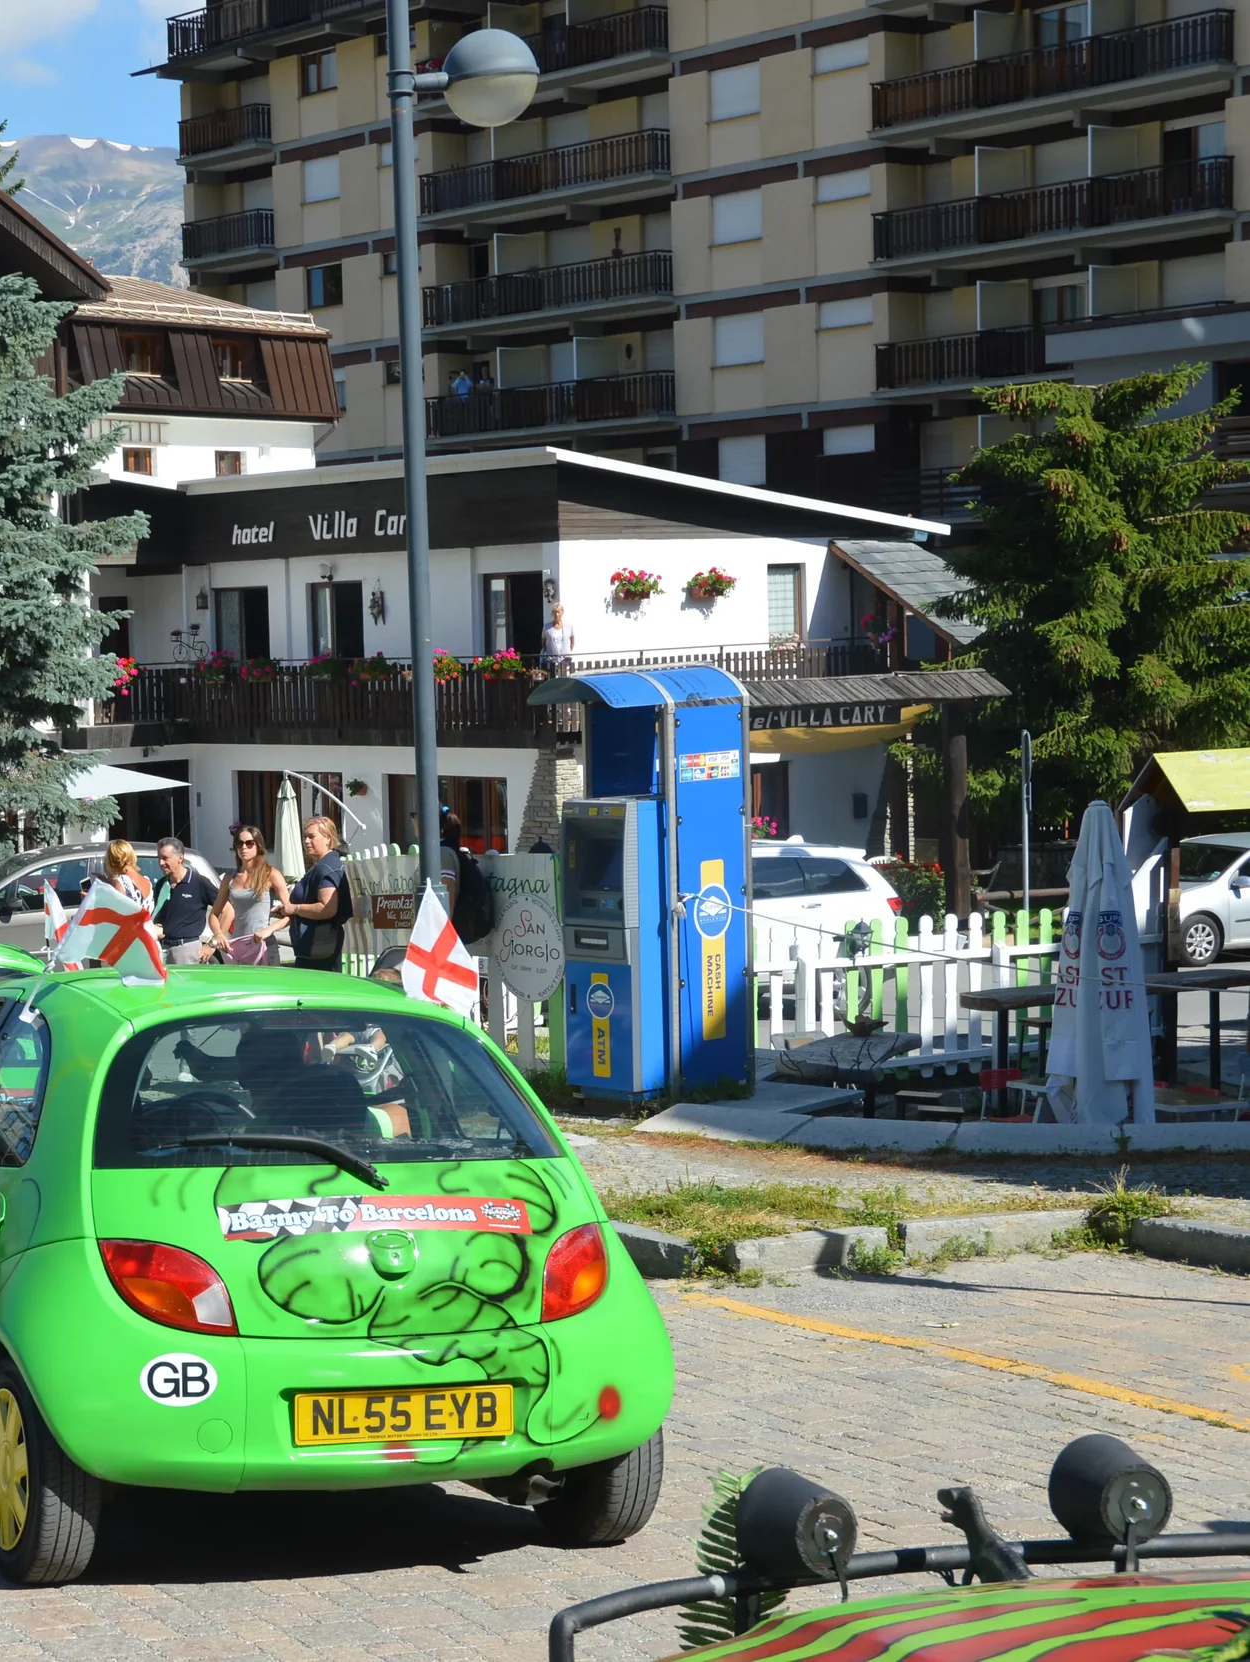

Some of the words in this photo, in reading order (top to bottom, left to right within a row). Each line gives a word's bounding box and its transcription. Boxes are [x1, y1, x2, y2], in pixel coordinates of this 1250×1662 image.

[232, 521, 275, 546] hotel
[308, 510, 358, 540] Villa
[374, 509, 407, 536] Car
[839, 705, 887, 725] CARY
[487, 872, 551, 899] tagna
[597, 1027, 606, 1066] ATM
[228, 1207, 315, 1233] Barmy
[320, 1204, 356, 1224] To
[358, 1202, 478, 1223] Barcelona
[147, 1361, 210, 1398] GB
[312, 1395, 411, 1436] NL55
[424, 1391, 498, 1431] EYB
